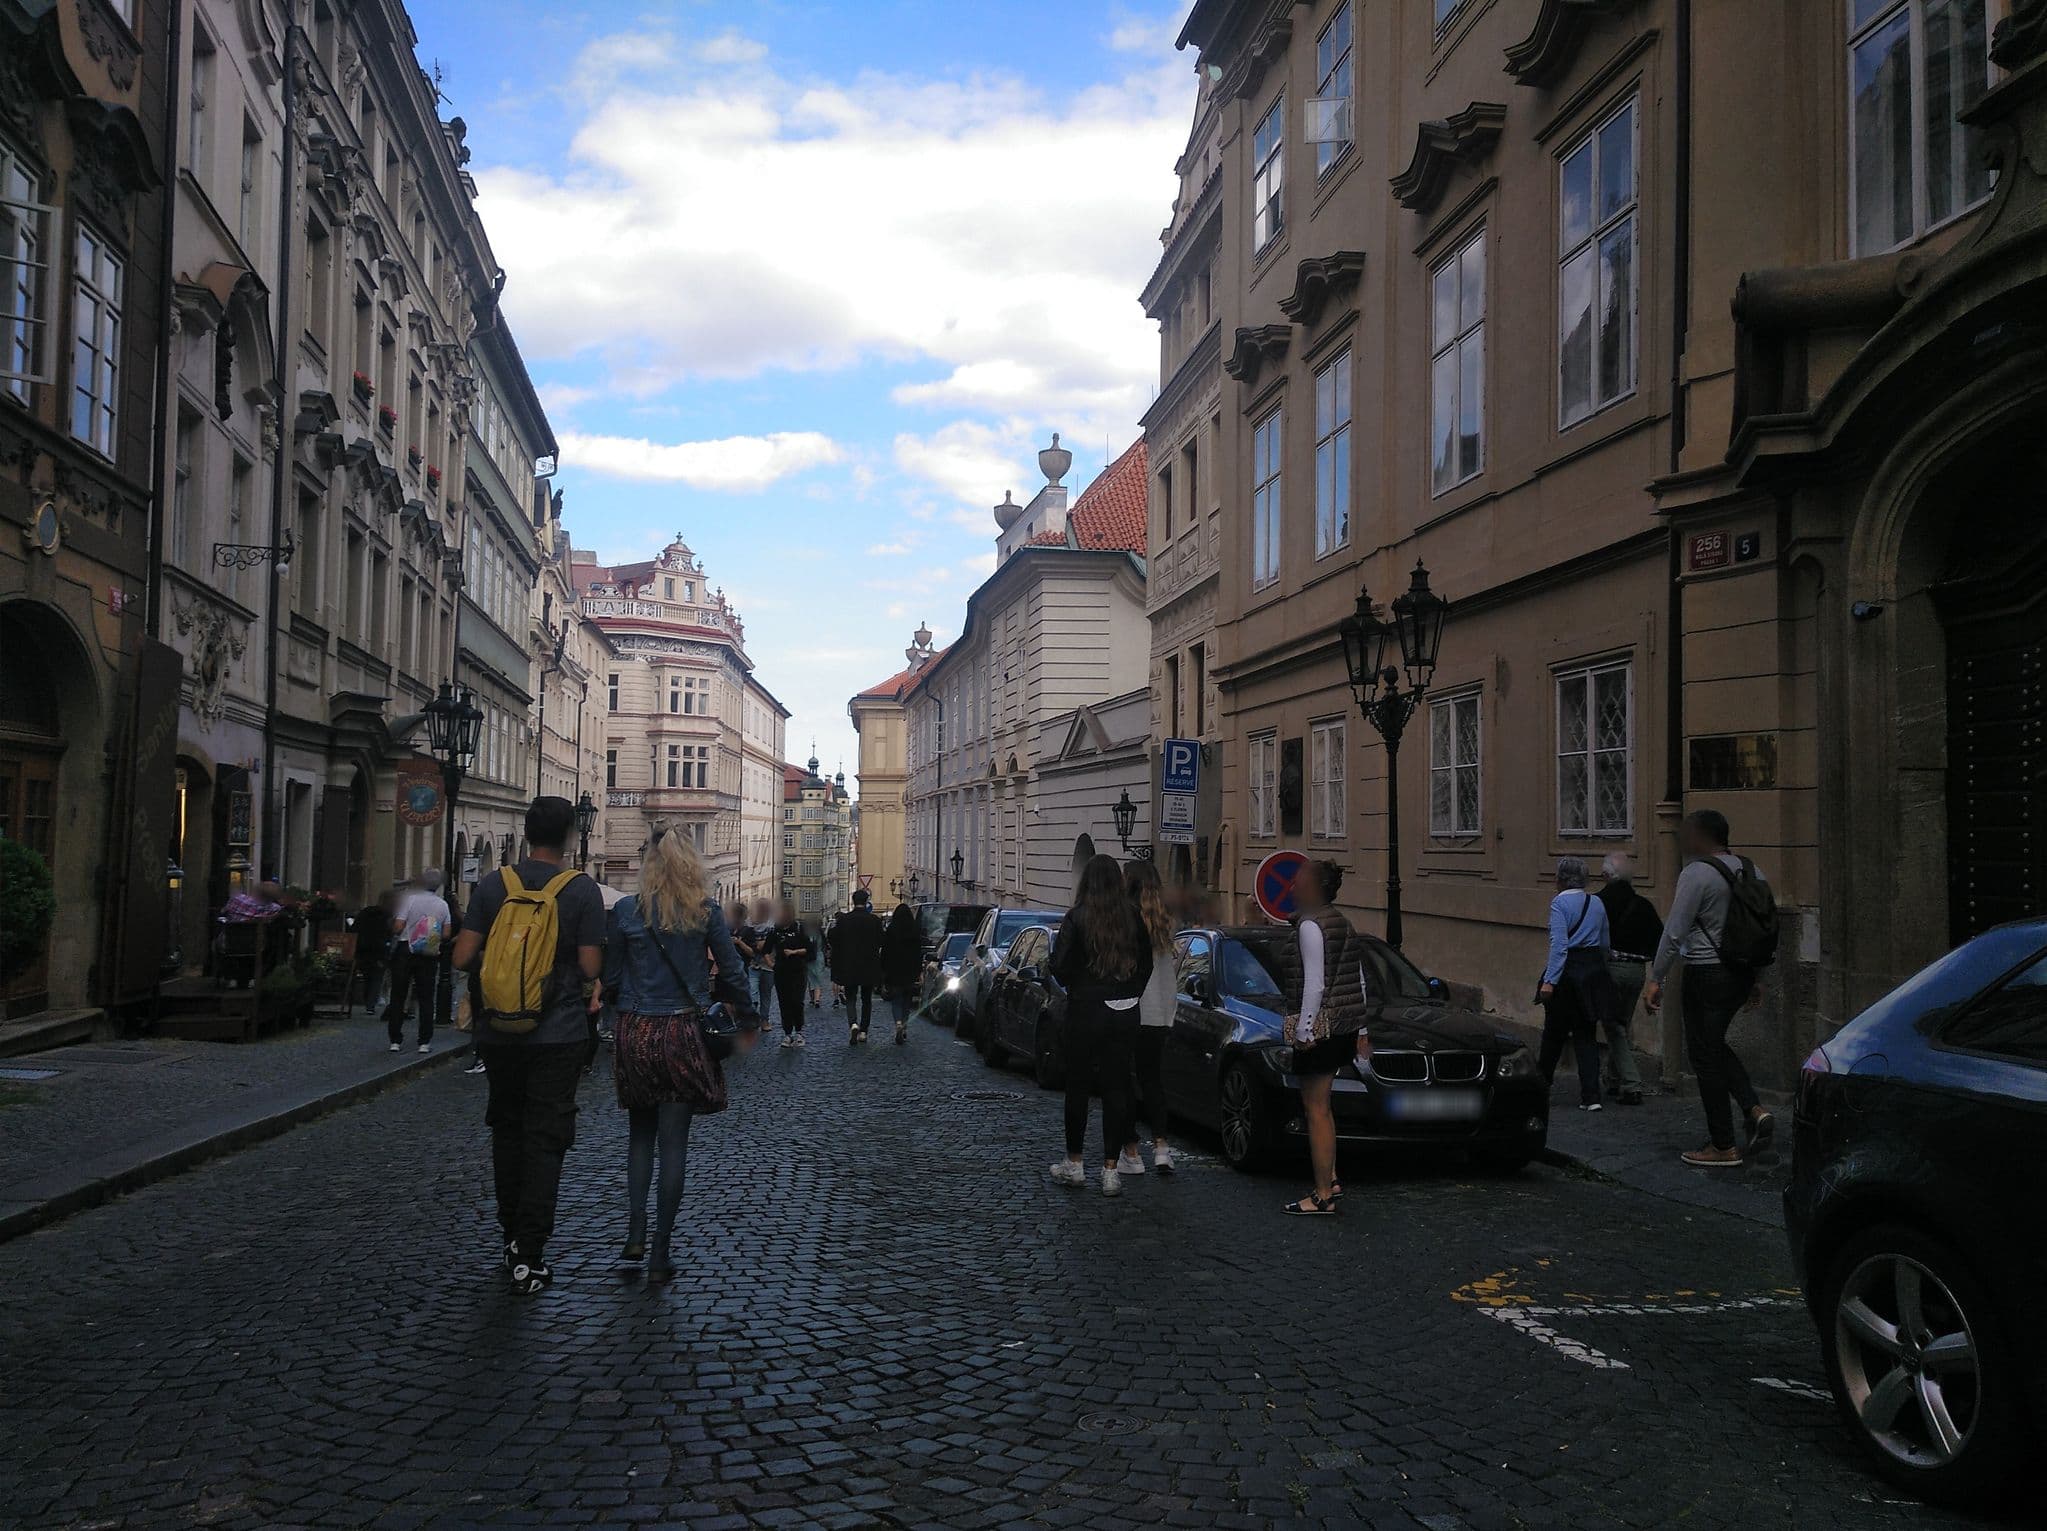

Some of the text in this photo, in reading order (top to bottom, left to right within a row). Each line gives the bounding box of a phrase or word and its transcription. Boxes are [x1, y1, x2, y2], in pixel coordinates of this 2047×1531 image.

[1696, 536, 1721, 552] 256
[1741, 539, 1750, 554] 5
[1171, 745, 1192, 775] P
